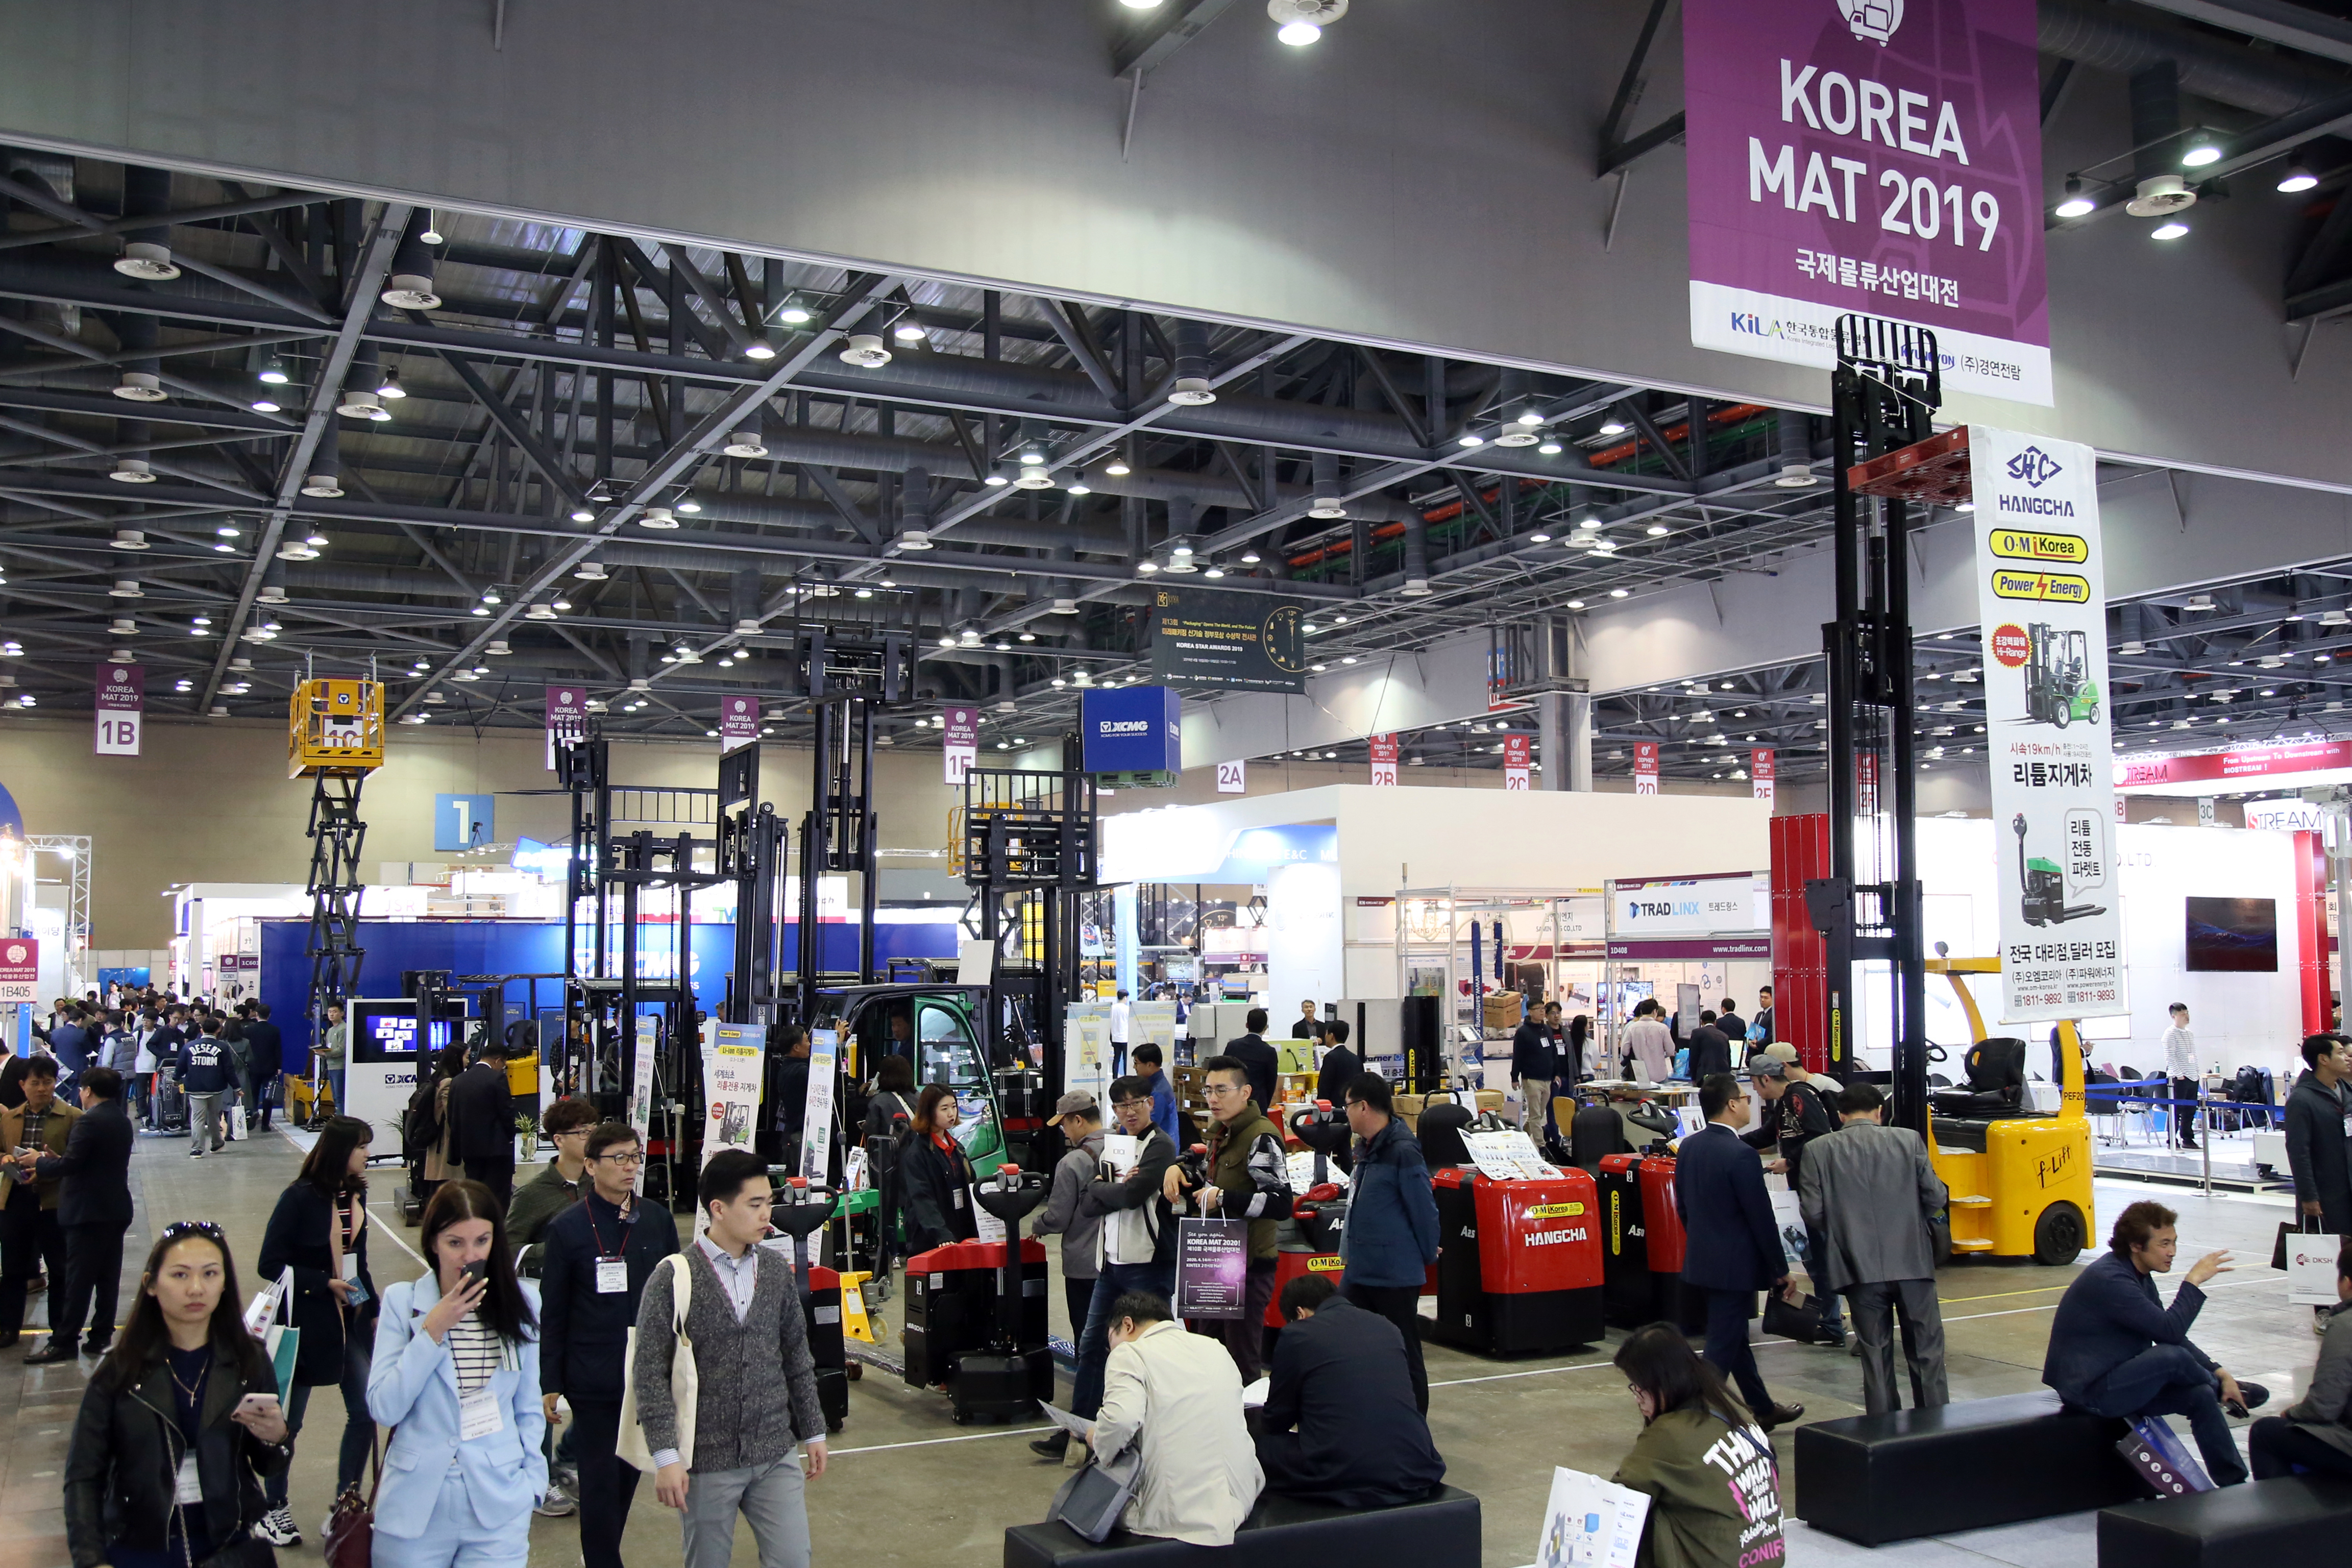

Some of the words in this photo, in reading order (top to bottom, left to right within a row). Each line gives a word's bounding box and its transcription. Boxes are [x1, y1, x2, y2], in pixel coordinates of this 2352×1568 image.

[1780, 58, 1969, 165] KOREA
[1749, 136, 1867, 223] MAT
[1879, 169, 1999, 251] 2019
[1795, 249, 1959, 308] 국제물류산업대전
[1801, 338, 1825, 348] Integrated
[1961, 354, 2021, 381] (주)경연전람
[1999, 494, 2075, 517] HANGCHA
[2000, 576, 2034, 593] Power
[2050, 579, 2083, 598] Energy
[1996, 635, 2026, 647] 초강력파워
[1996, 647, 2026, 658] Hi-Range
[106, 685, 135, 694] KOREA
[554, 706, 578, 714] KOREA
[729, 714, 752, 722] KOREA
[102, 720, 135, 745] 1B
[1111, 720, 1148, 732] XCMG
[2010, 742, 2061, 756] 시속19km/h
[2241, 755, 2270, 764] Upstream
[2273, 752, 2282, 760] To
[2284, 749, 2324, 759] Downstream
[949, 755, 972, 775] 1F
[2223, 764, 2262, 774] BIOSTREAM
[1219, 765, 1242, 785] 2A
[2013, 762, 2092, 788] 리튬지게차
[2200, 805, 2213, 820] 3C
[452, 800, 470, 844] 1
[2071, 819, 2091, 837] 리튬
[2247, 811, 2323, 830] STREAM
[2072, 840, 2092, 857] 전동
[2072, 861, 2101, 878] 파렛트
[1640, 901, 1700, 917] TRADLINX
[1708, 901, 1738, 912] 트레드링스
[1712, 944, 1768, 953] www.tradlinx.com
[2010, 944, 2032, 964] 전국
[2095, 940, 2116, 959] 모집
[2012, 969, 2062, 985] (주)오엠코리아
[2065, 966, 2115, 981] (주)파워에너지
[1, 986, 31, 997] 1B405
[2017, 983, 2058, 992] www.om-korea.kr
[2067, 980, 2115, 989] www.powerenergy.kr
[188, 1043, 222, 1057] DESERT
[736, 1047, 755, 1056] 리튬지게차
[191, 1056, 218, 1066] STORM
[714, 1069, 735, 1080] 세계최초
[717, 1081, 740, 1092] 리튬전용
[740, 1082, 757, 1093] 지게차
[2064, 1092, 2085, 1100] PEF20
[1525, 1227, 1587, 1246] HANGCHA
[906, 1322, 924, 1333] HANGCHA
[1735, 1457, 1772, 1494] WHAT
[1748, 1491, 1779, 1524] WILL
